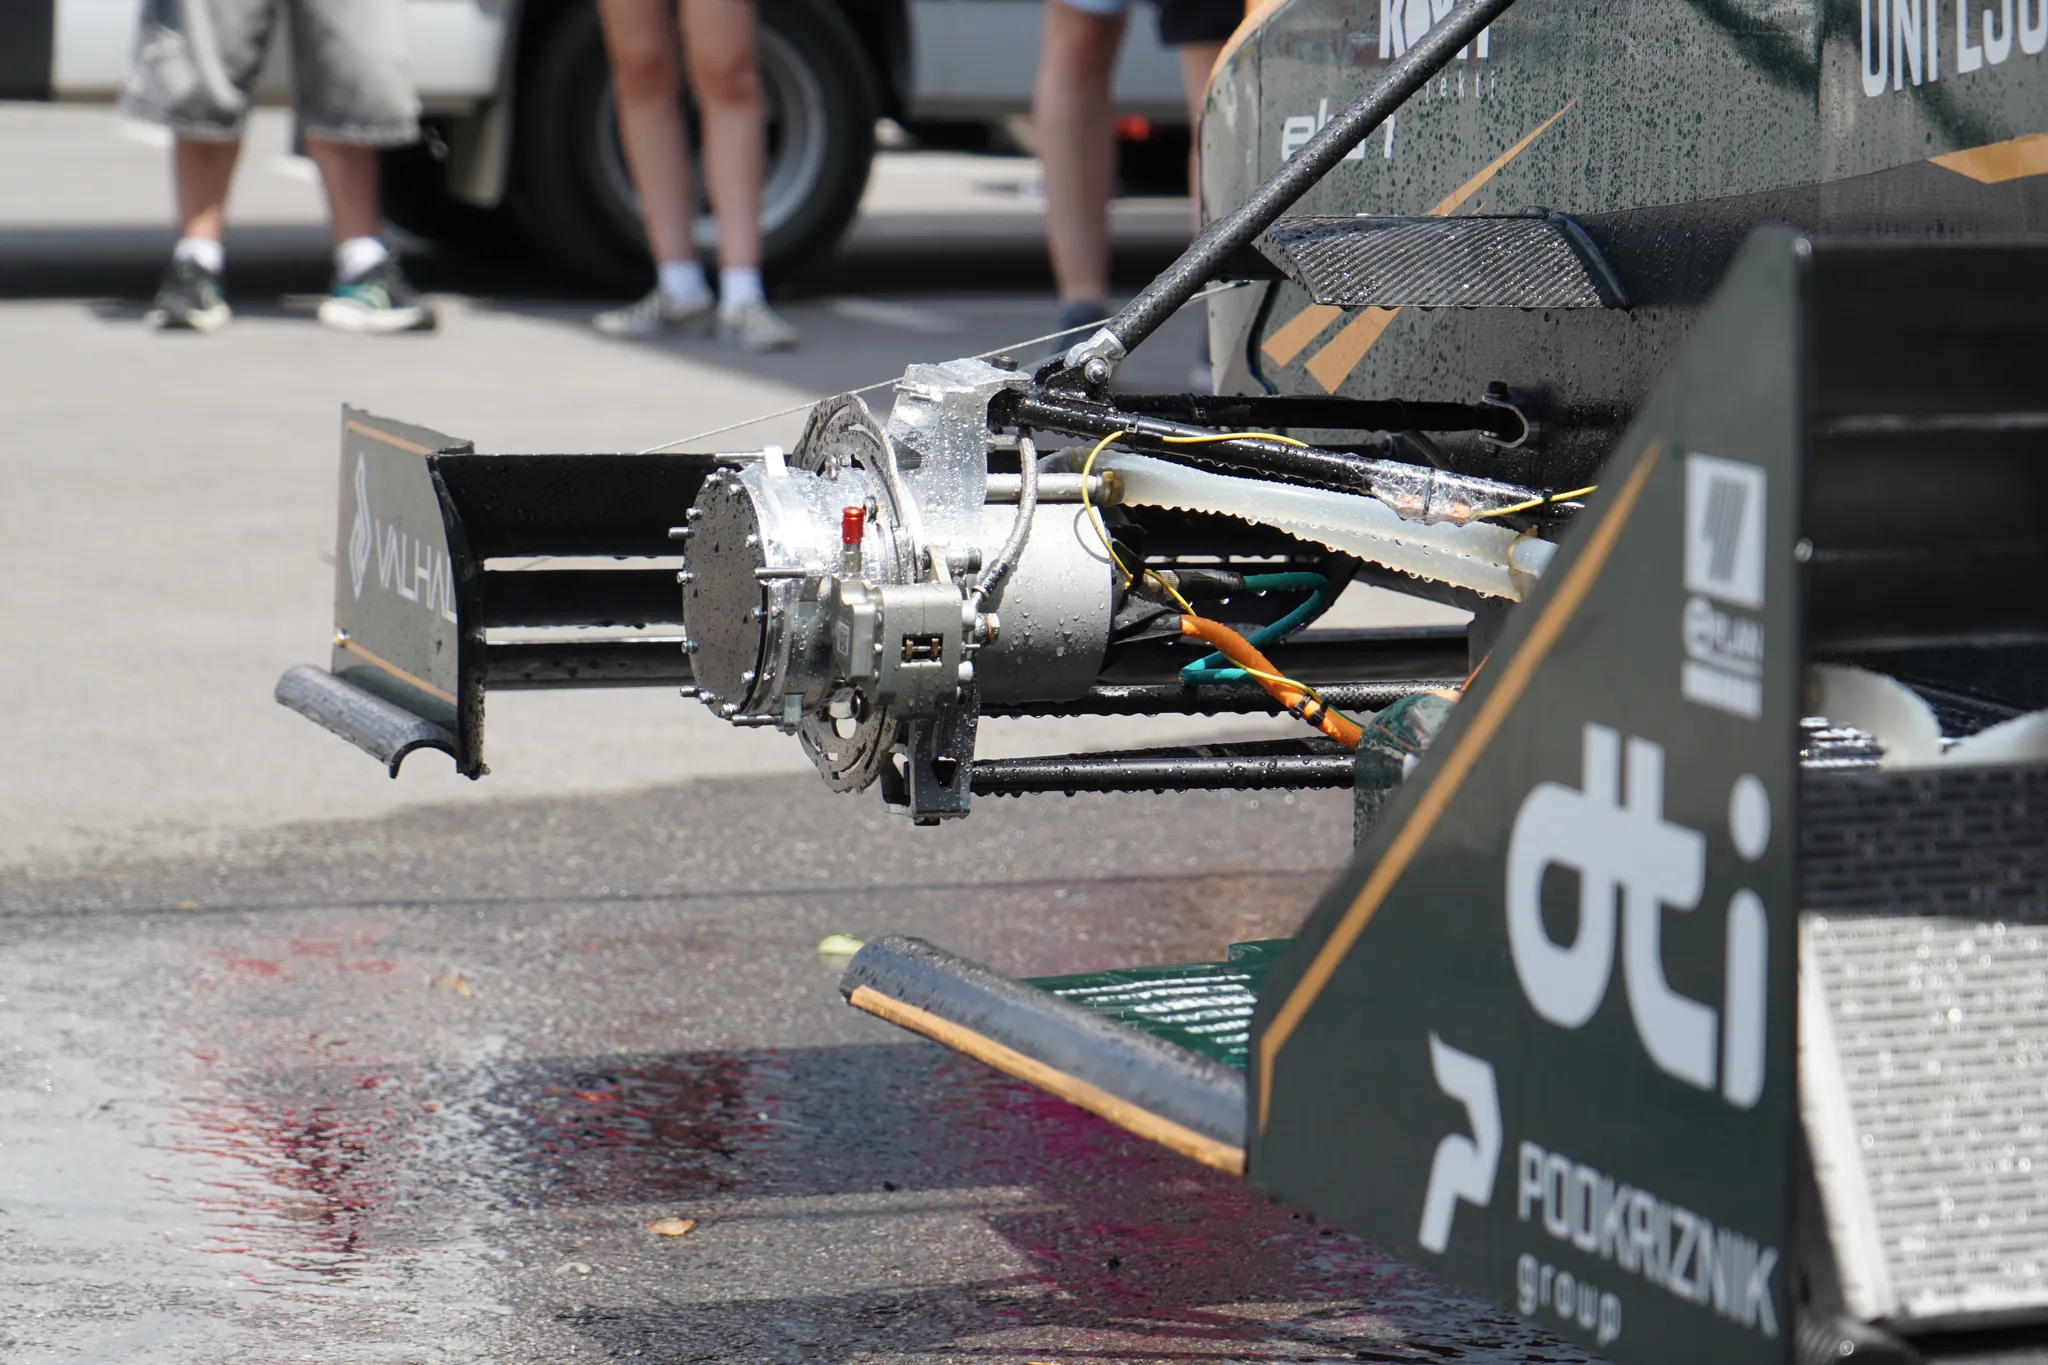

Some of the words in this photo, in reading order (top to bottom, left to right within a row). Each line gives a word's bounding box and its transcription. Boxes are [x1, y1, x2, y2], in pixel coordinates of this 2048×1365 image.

[1426, 70, 1496, 104] jekti
[1861, 0, 1938, 97] UNI
[1517, 1139, 1779, 1338] PODKRIZNIK
[1516, 1253, 1622, 1346] group
